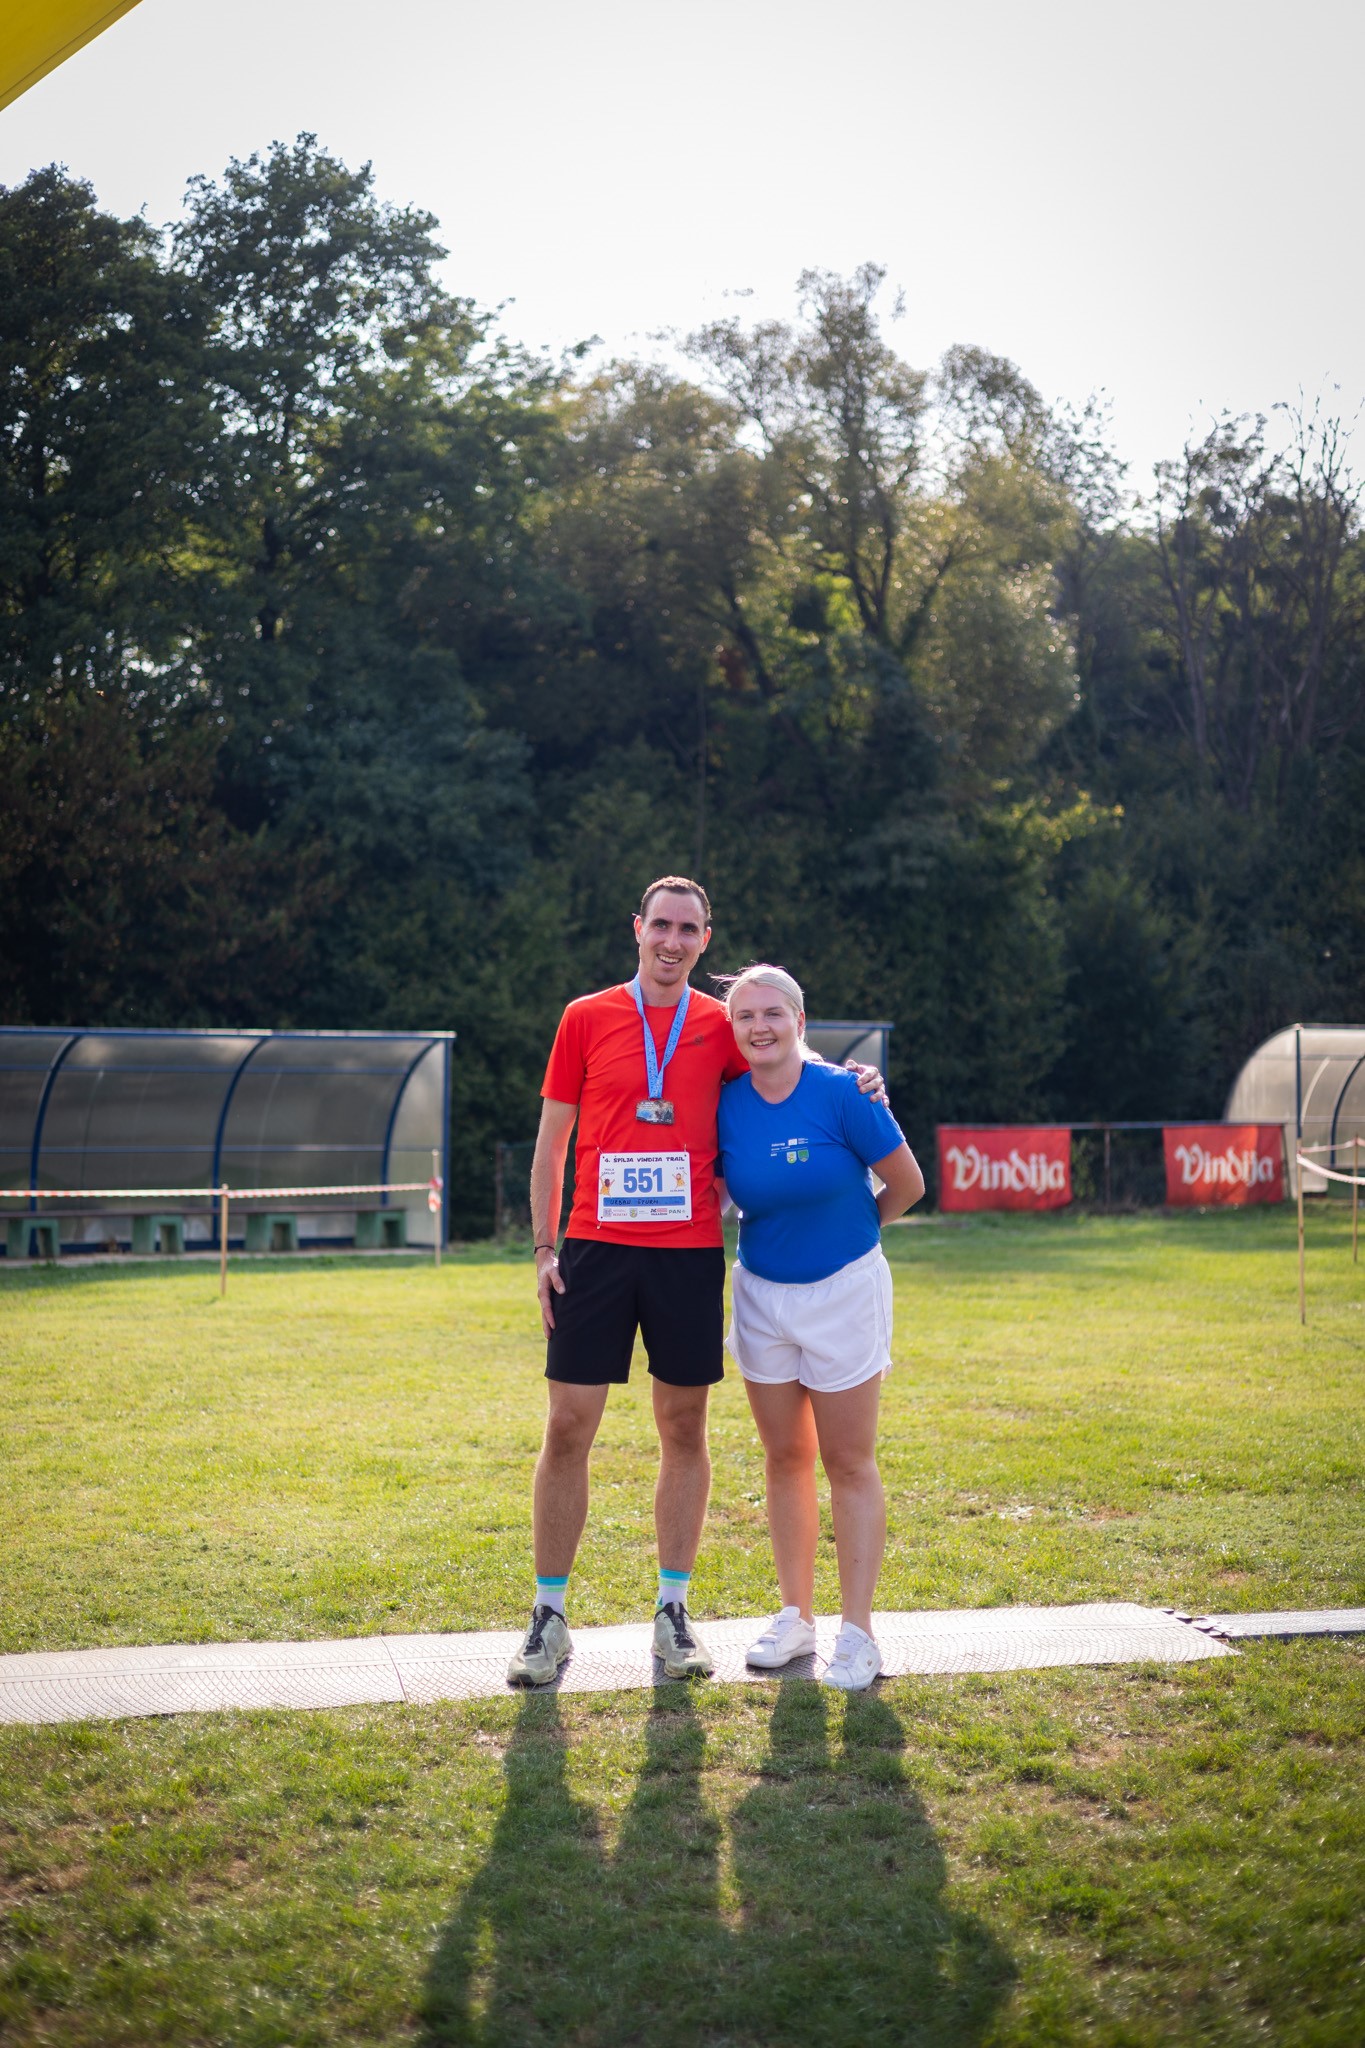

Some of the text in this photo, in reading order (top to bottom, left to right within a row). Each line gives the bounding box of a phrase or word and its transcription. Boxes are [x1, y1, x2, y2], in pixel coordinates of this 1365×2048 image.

[624, 1167, 663, 1193] 551
[946, 1144, 1065, 1195] Vindija
[1174, 1143, 1274, 1187] Vindija
